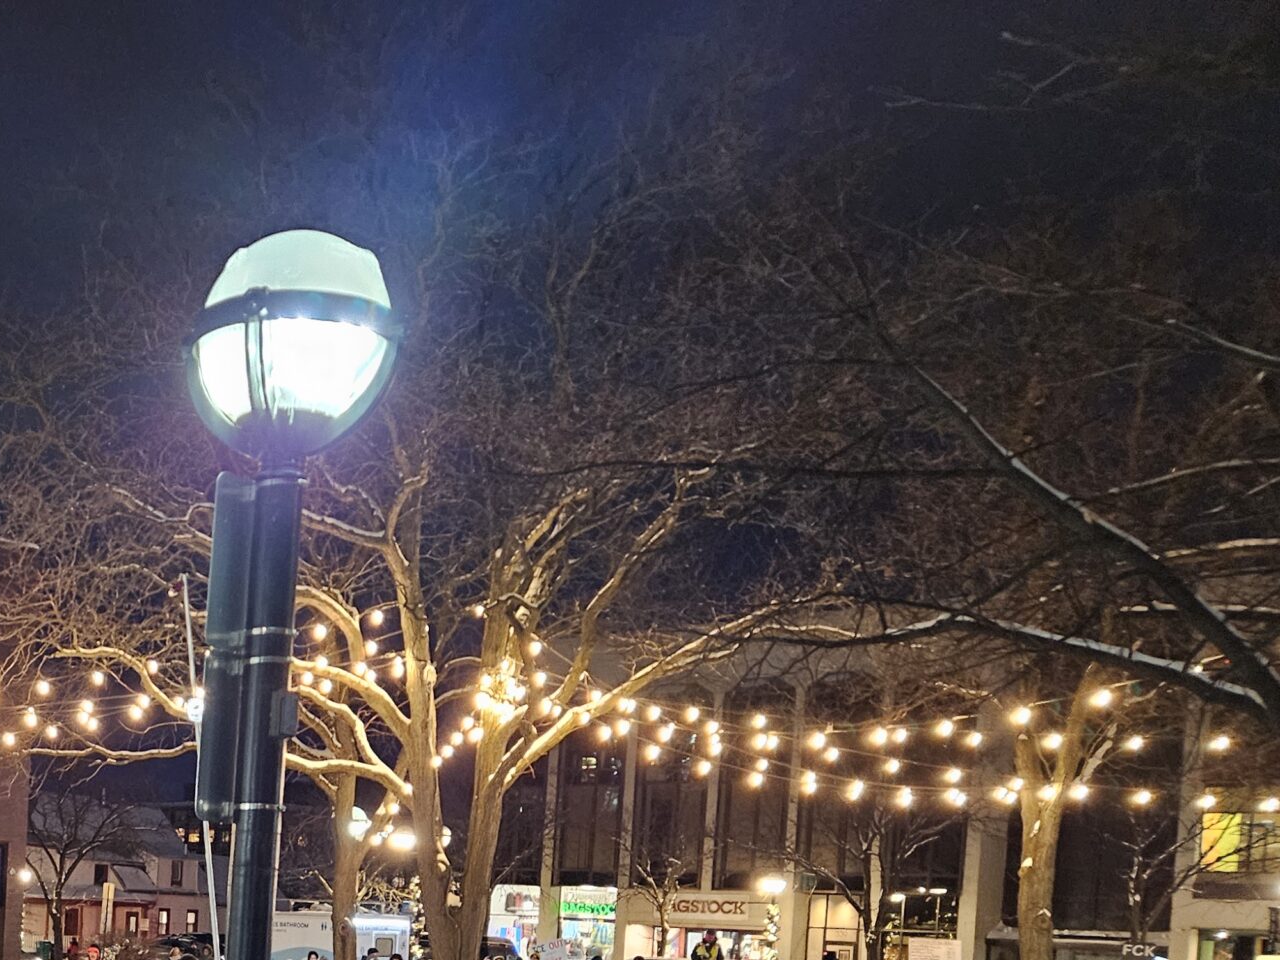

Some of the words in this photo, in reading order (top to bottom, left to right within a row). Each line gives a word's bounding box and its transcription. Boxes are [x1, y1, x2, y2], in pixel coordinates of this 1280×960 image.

[670, 900, 746, 914] AGSTOCK
[548, 939, 565, 951] OUT
[1122, 943, 1156, 957] FCK
